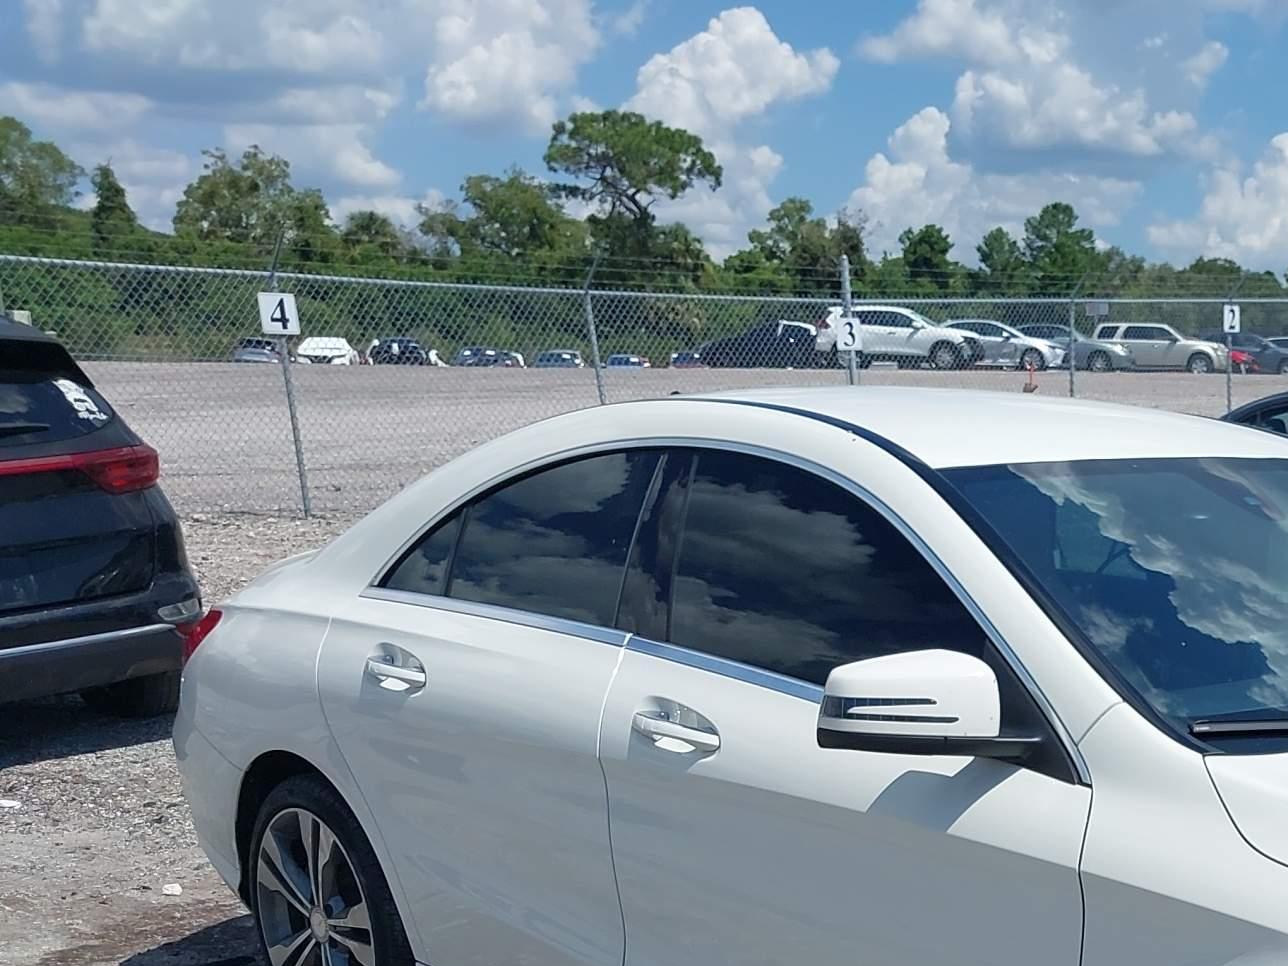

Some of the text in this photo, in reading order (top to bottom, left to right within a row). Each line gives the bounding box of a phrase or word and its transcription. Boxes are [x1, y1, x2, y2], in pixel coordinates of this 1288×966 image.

[270, 297, 290, 330] 4
[1228, 308, 1236, 330] 2
[842, 321, 856, 347] 3
